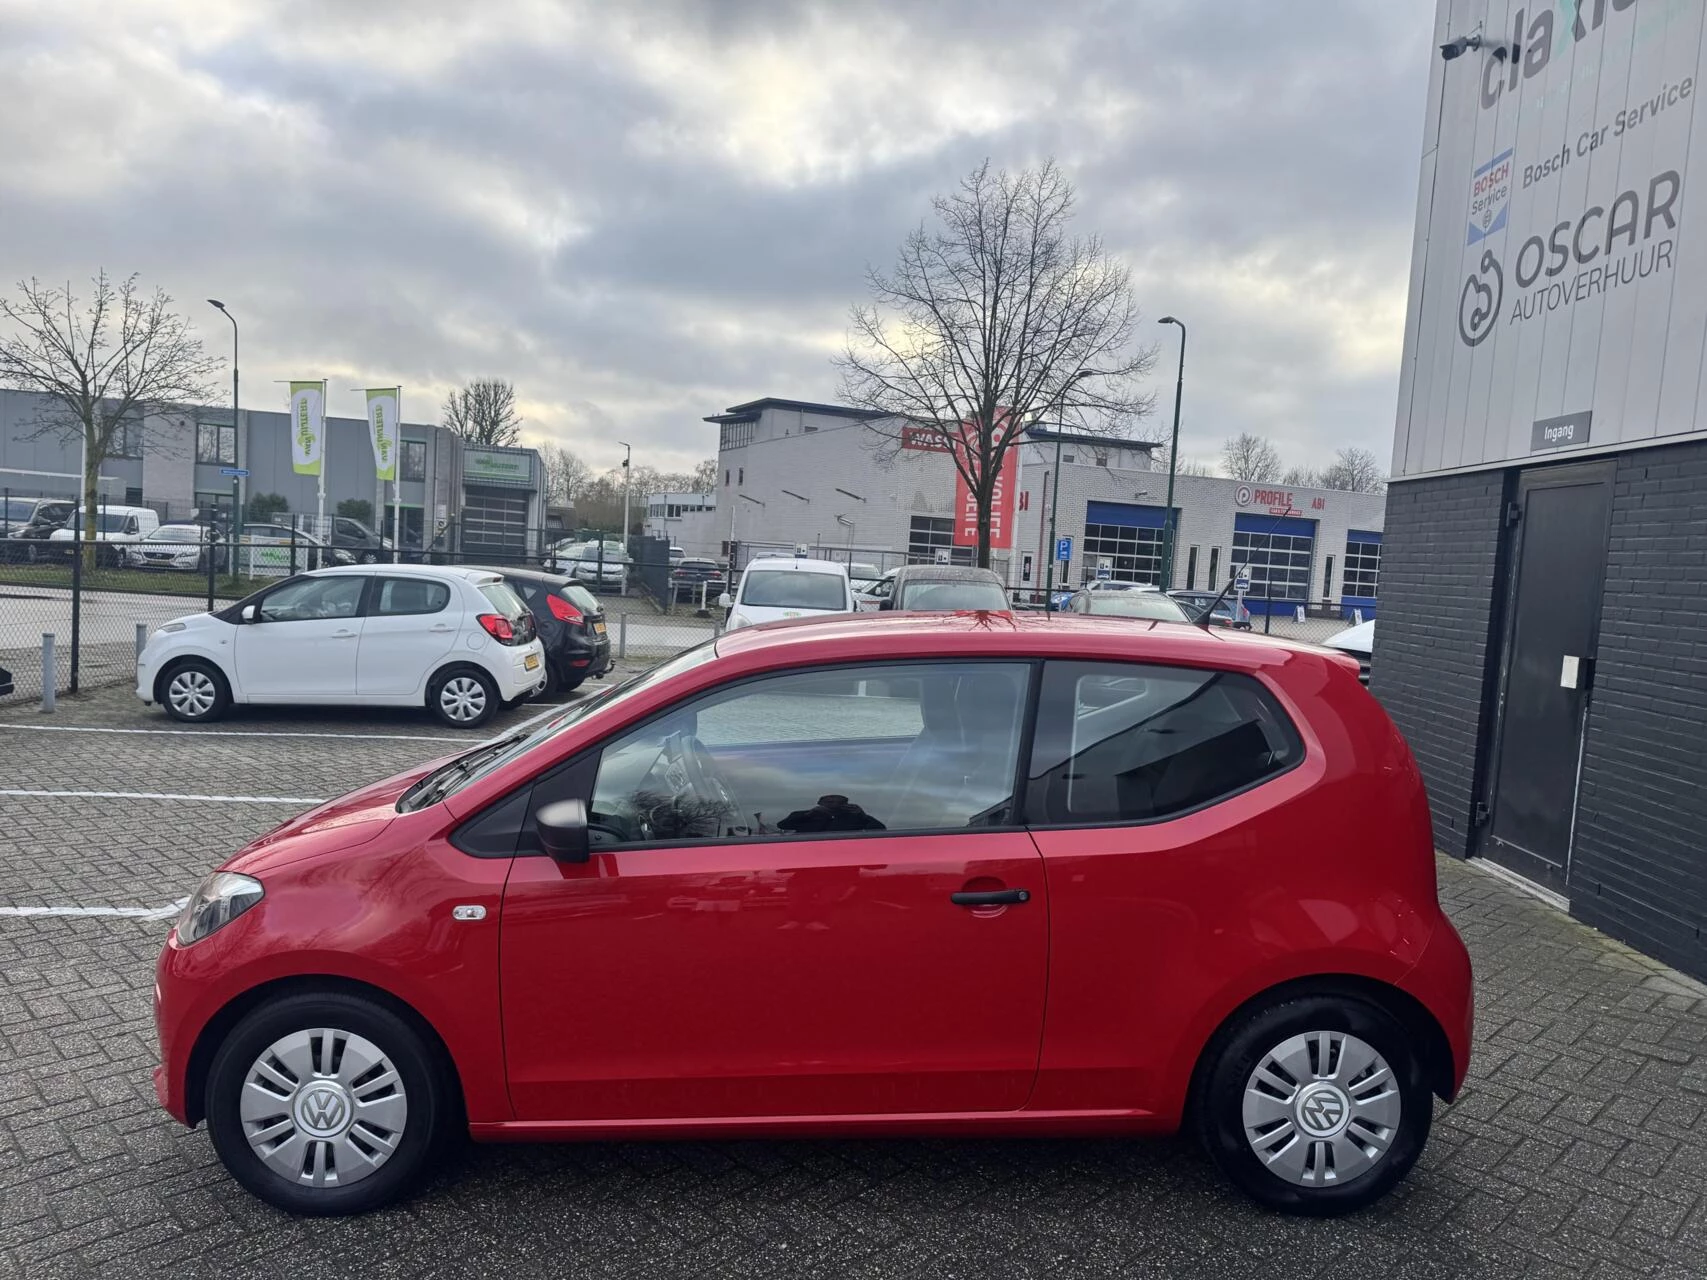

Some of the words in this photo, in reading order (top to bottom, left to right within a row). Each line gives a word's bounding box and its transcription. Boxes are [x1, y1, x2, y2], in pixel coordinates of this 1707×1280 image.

[1522, 143, 1570, 189] Bosch
[1576, 124, 1609, 157] Car
[1612, 76, 1692, 137] Service
[1473, 161, 1509, 198] BOSCH
[1471, 185, 1508, 216] Service
[1515, 169, 1681, 288] OSCAR
[1509, 239, 1673, 326] AUTOVERHUUR
[1544, 424, 1574, 442] Ingang
[1254, 489, 1293, 507] PROFILE
[1311, 497, 1326, 510] ABI
[1060, 540, 1068, 551] P
